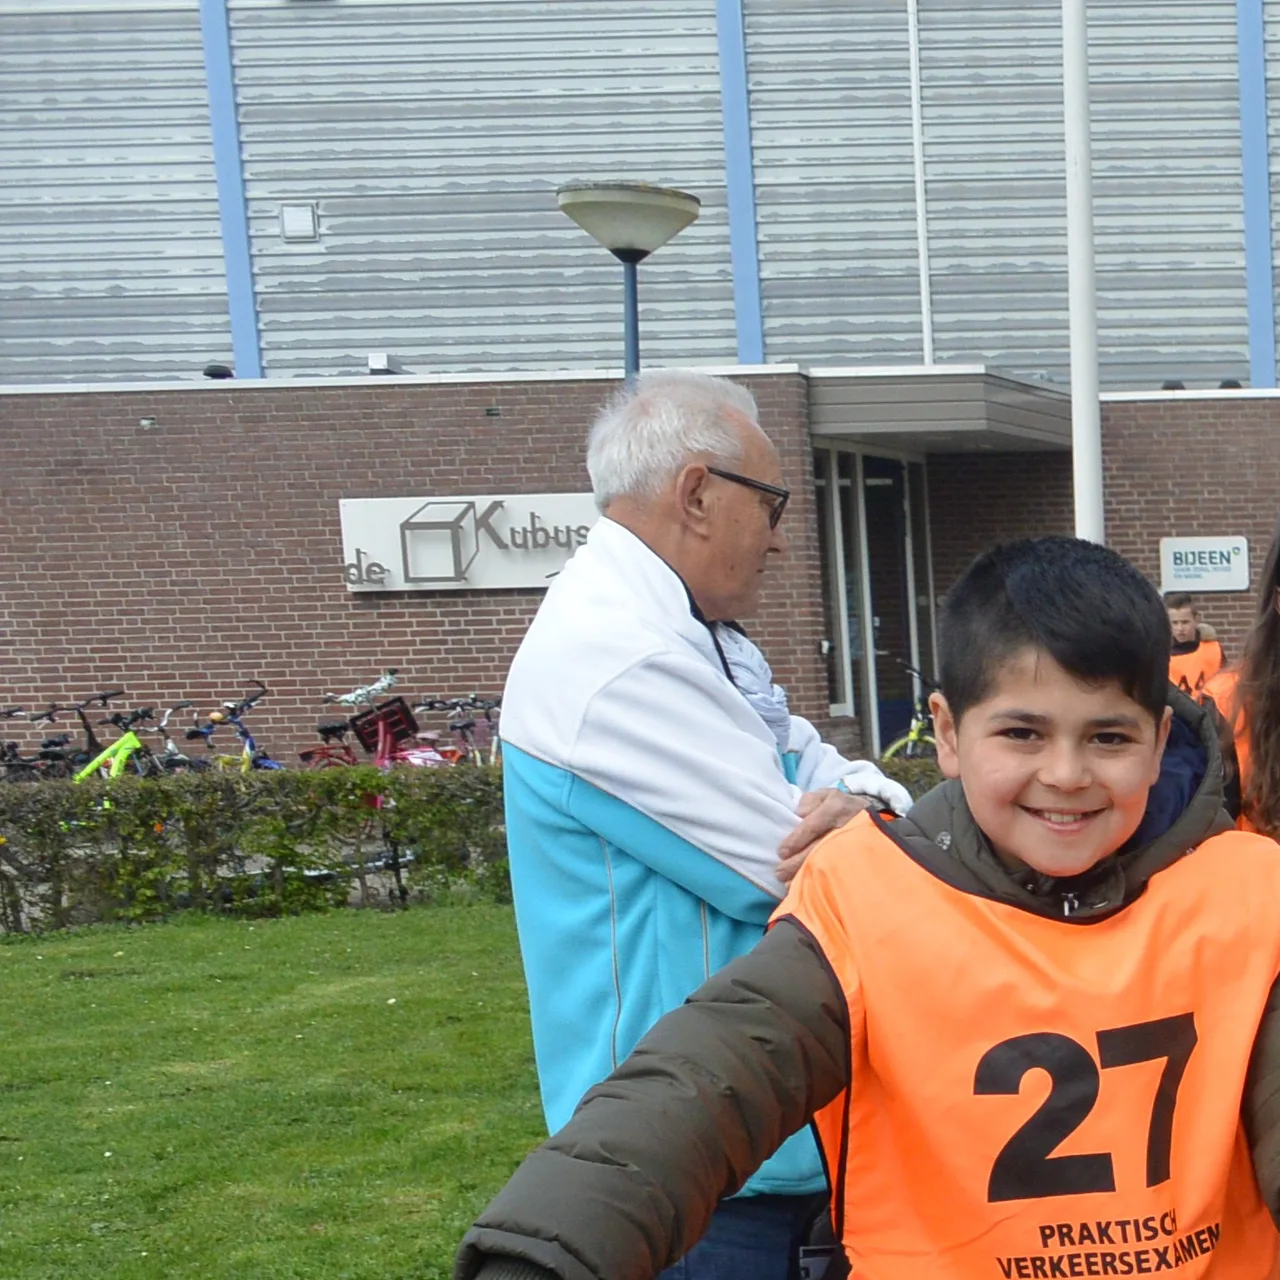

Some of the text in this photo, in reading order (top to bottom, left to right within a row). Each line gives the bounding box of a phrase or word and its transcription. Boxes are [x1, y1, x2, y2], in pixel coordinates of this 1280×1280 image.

[474, 499, 591, 552] Kubus
[344, 547, 389, 585] de
[1173, 550, 1232, 566] BIJEEN
[972, 1010, 1199, 1204] 27
[995, 1222, 1221, 1280] VERKEERSEXAMEN
[1038, 1207, 1178, 1249] PRAKTISCH
